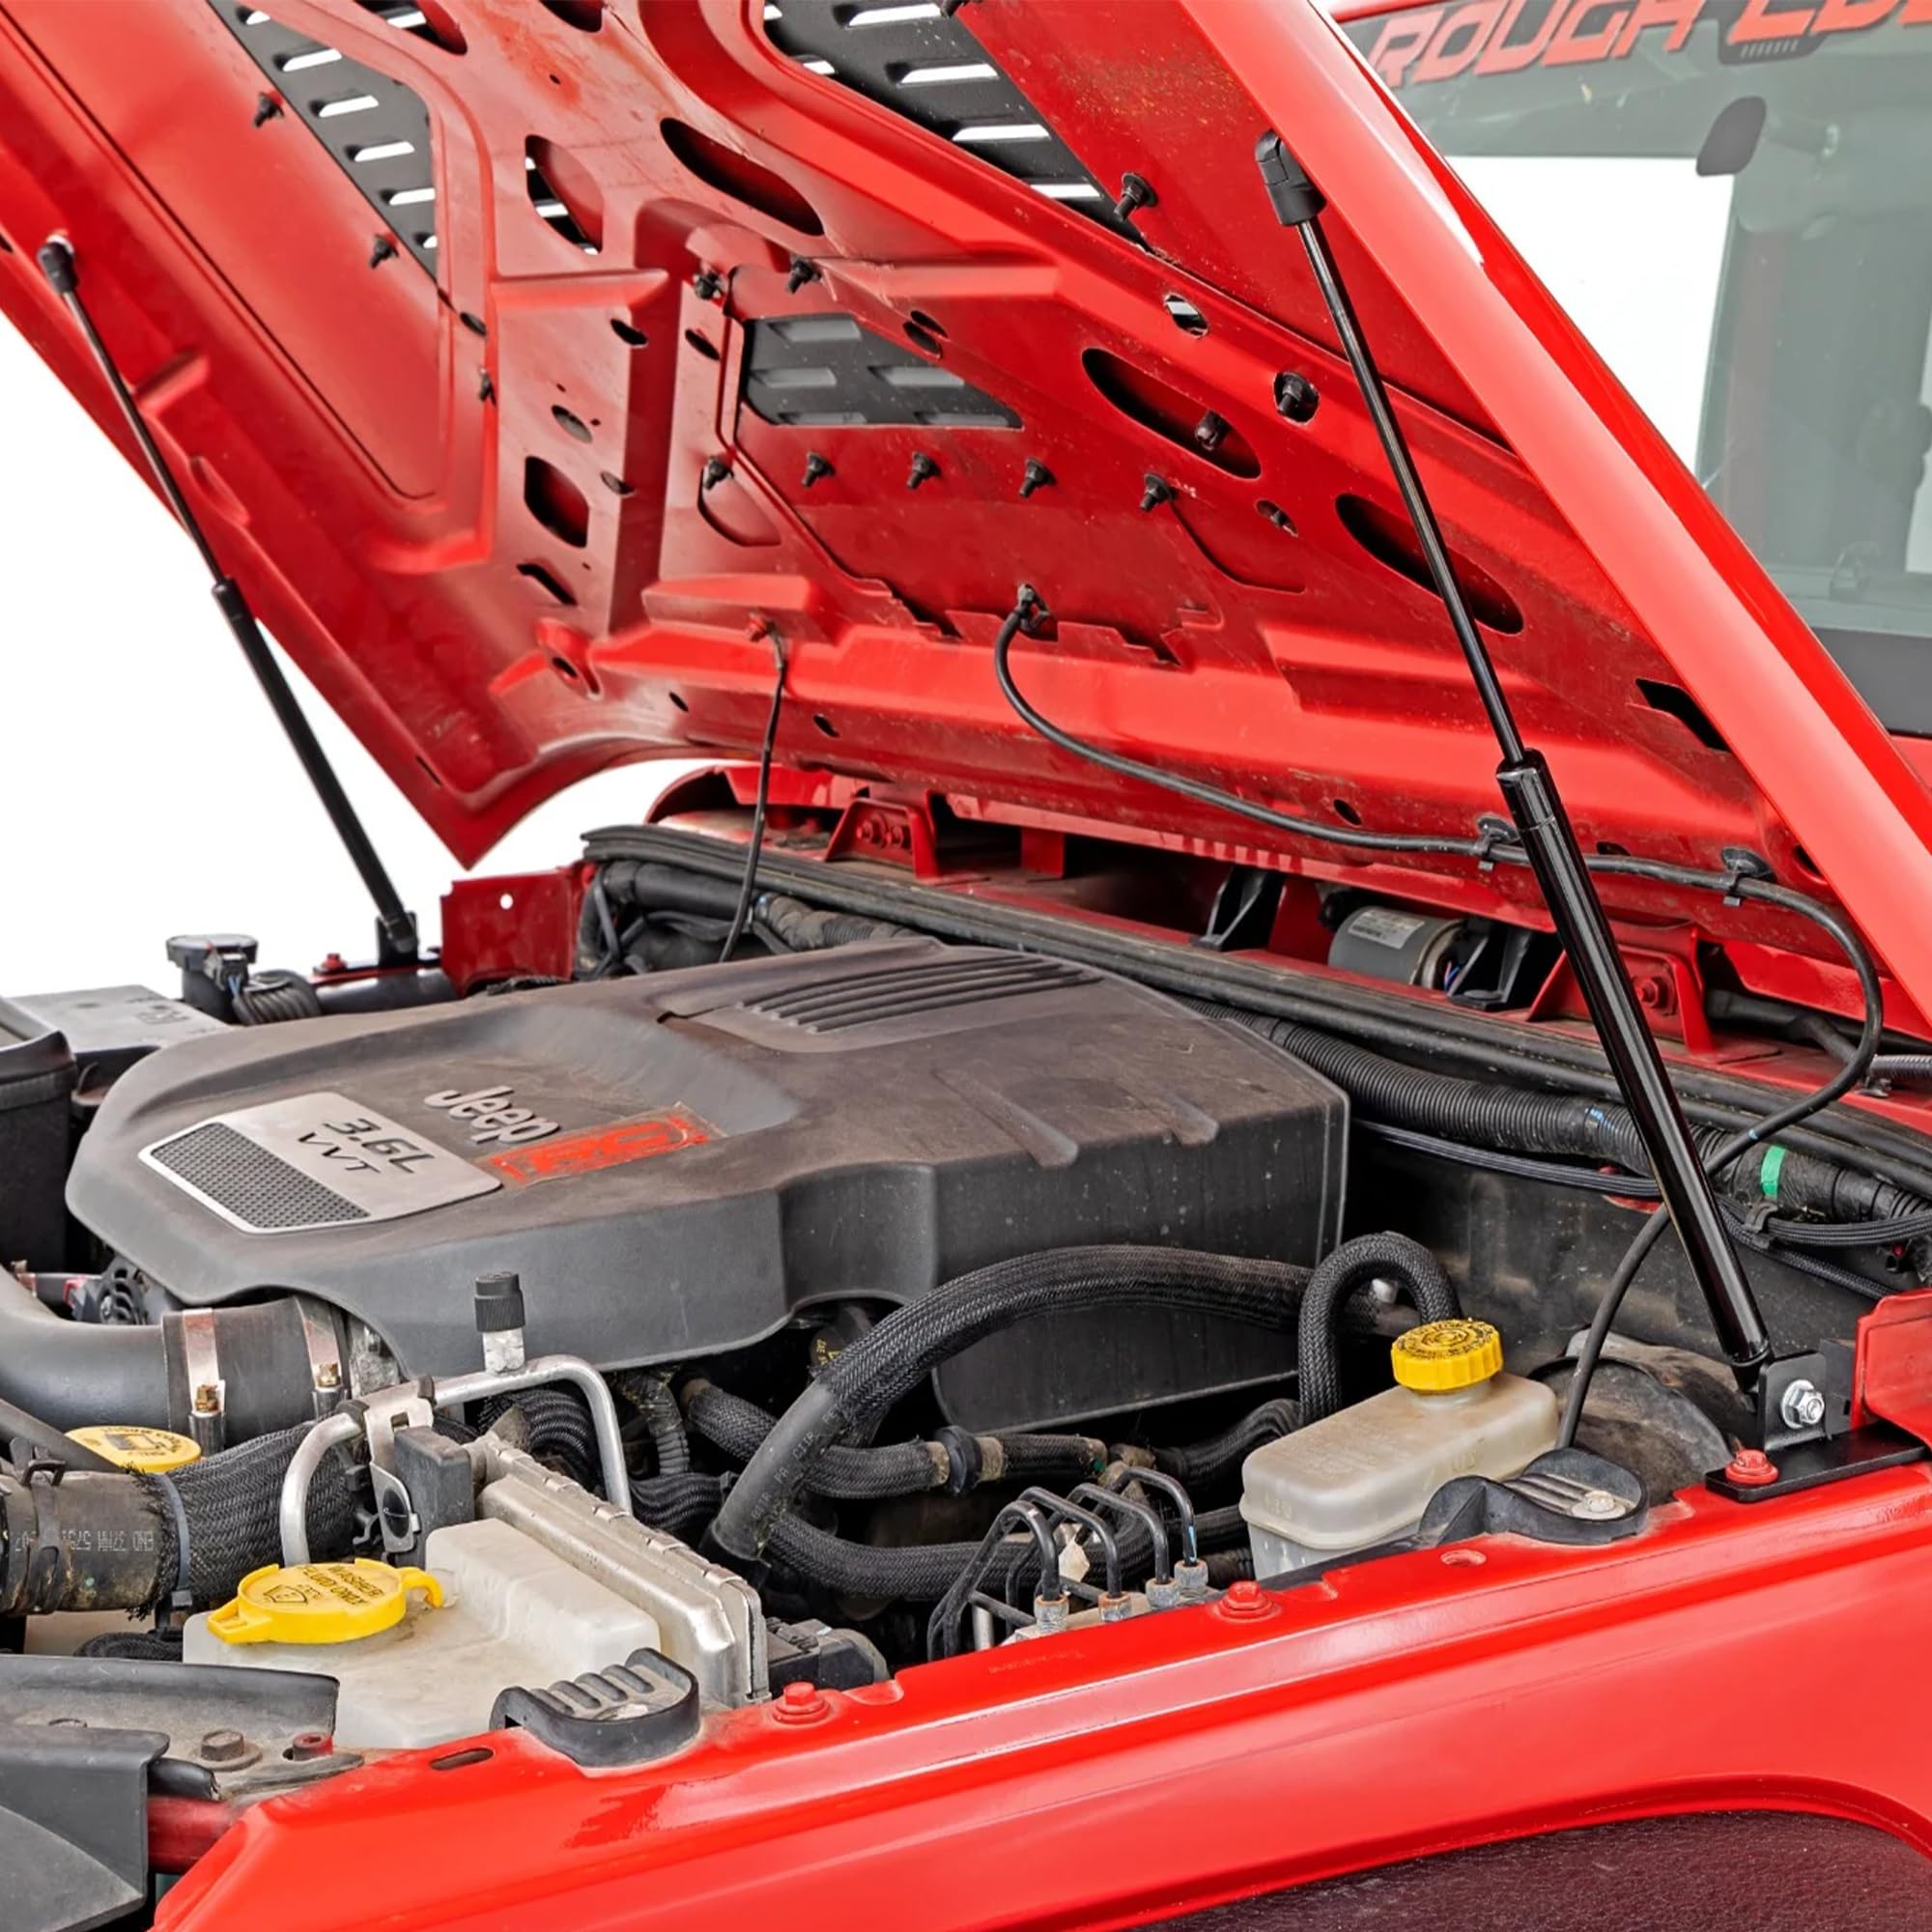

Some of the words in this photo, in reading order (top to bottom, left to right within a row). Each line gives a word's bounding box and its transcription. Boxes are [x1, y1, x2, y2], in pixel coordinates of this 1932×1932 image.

[1366, 0, 1708, 89] ROUGH
[423, 1085, 561, 1144] Jeep
[297, 1131, 382, 1175] VVT
[322, 1117, 436, 1175] 3.6L
